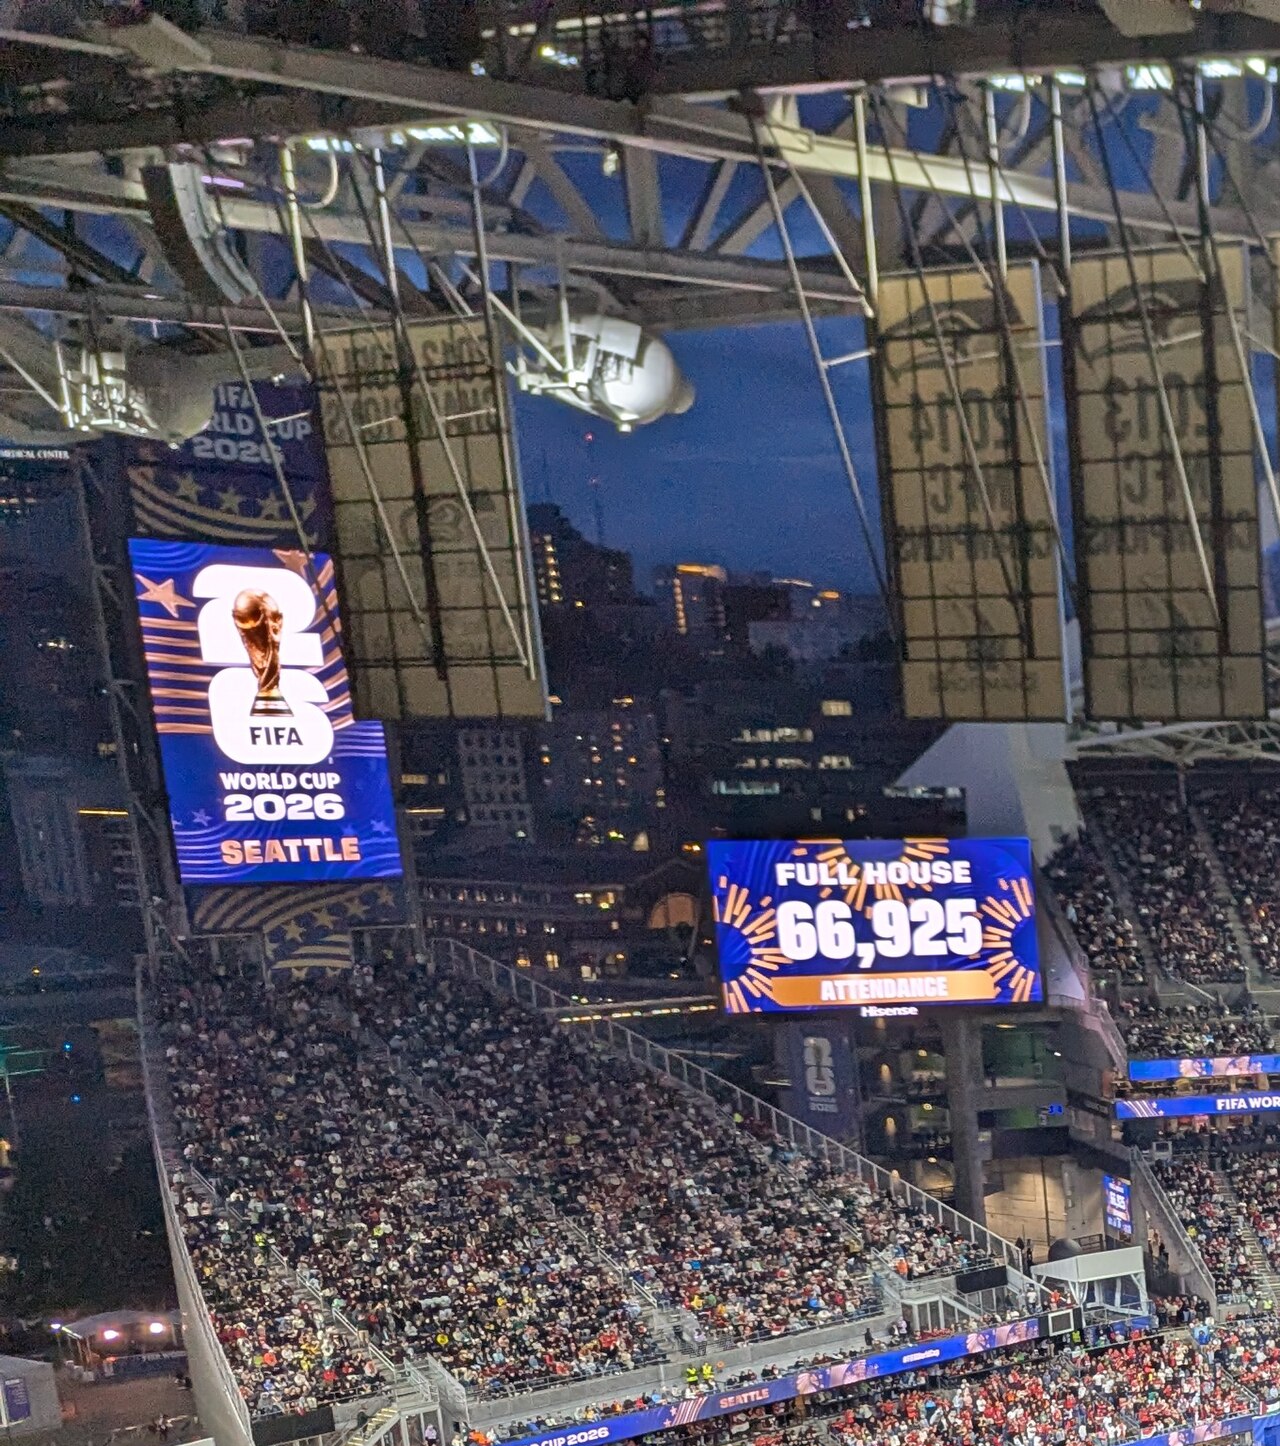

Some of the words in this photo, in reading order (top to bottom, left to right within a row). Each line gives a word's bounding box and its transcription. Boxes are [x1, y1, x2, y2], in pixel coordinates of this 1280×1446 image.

[193, 436, 285, 464] 2026
[250, 726, 304, 747] FIFA
[219, 772, 296, 791] WORLD
[299, 771, 341, 790] CUP
[223, 793, 345, 822] 2026
[220, 836, 361, 865] SEATTLE
[774, 861, 858, 888] FULL
[863, 860, 972, 886] HOUSE
[775, 898, 984, 969] 66,925
[820, 976, 949, 1002] ATTENDANCE
[860, 1004, 919, 1018] Hisense
[1216, 1097, 1247, 1111] FIFA
[719, 1387, 770, 1411] SEATTLE
